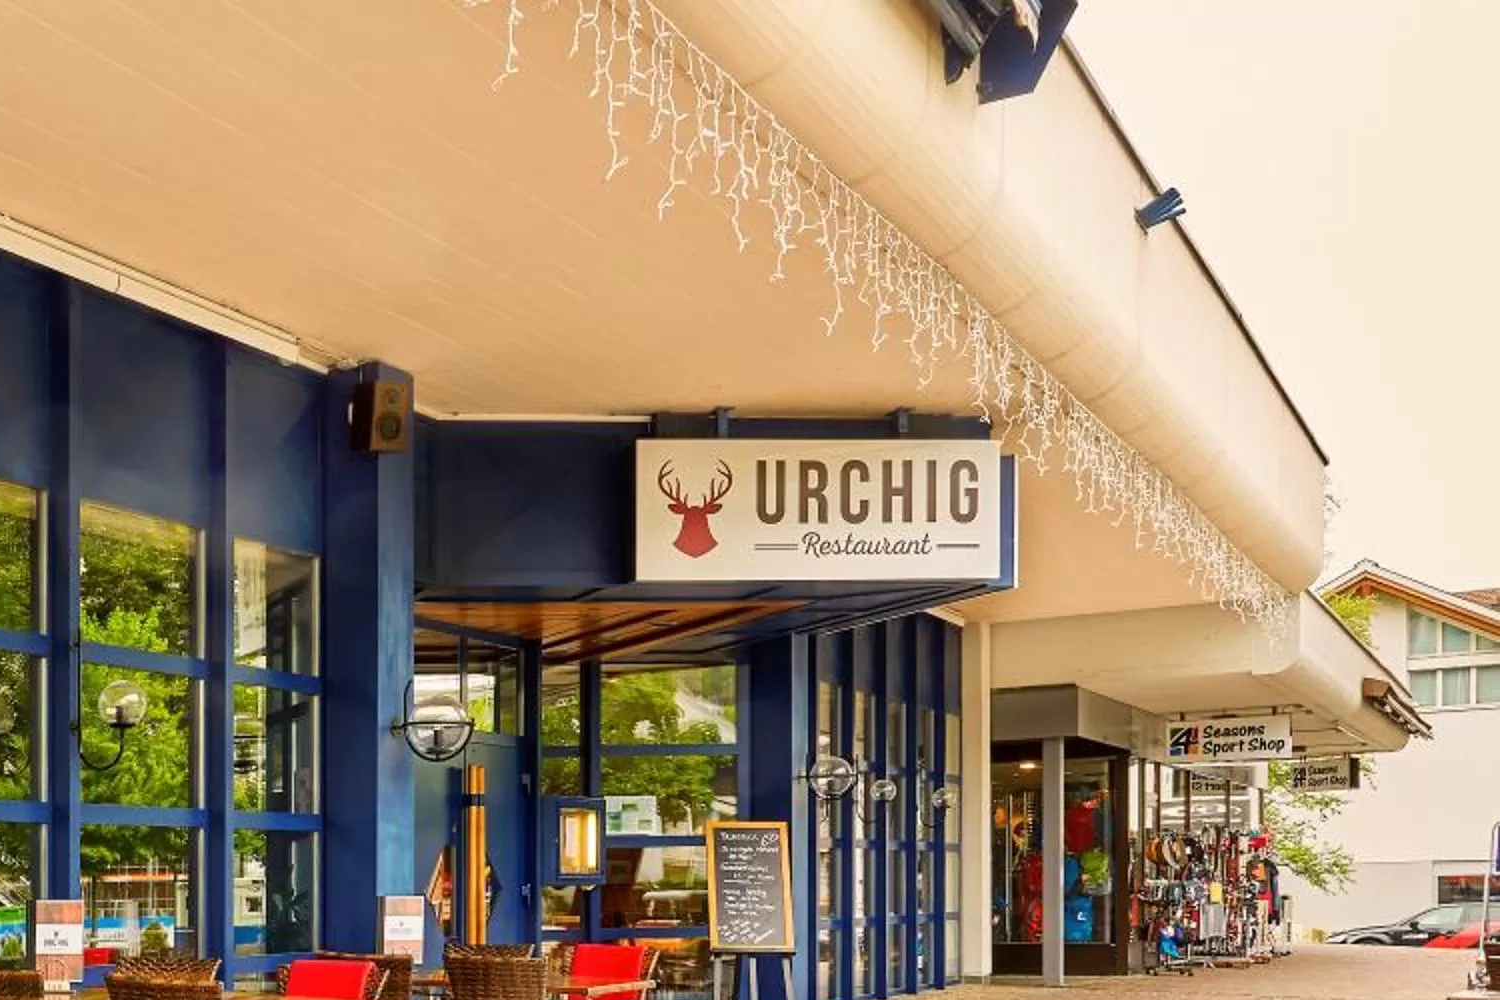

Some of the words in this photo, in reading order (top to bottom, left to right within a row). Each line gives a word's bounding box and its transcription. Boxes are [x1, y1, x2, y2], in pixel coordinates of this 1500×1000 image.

[755, 459, 980, 525] URCHIG
[801, 531, 932, 558] Restaurant
[1202, 725, 1266, 739] Seasons
[1202, 740, 1246, 757] Sport
[1247, 738, 1286, 754] Shop
